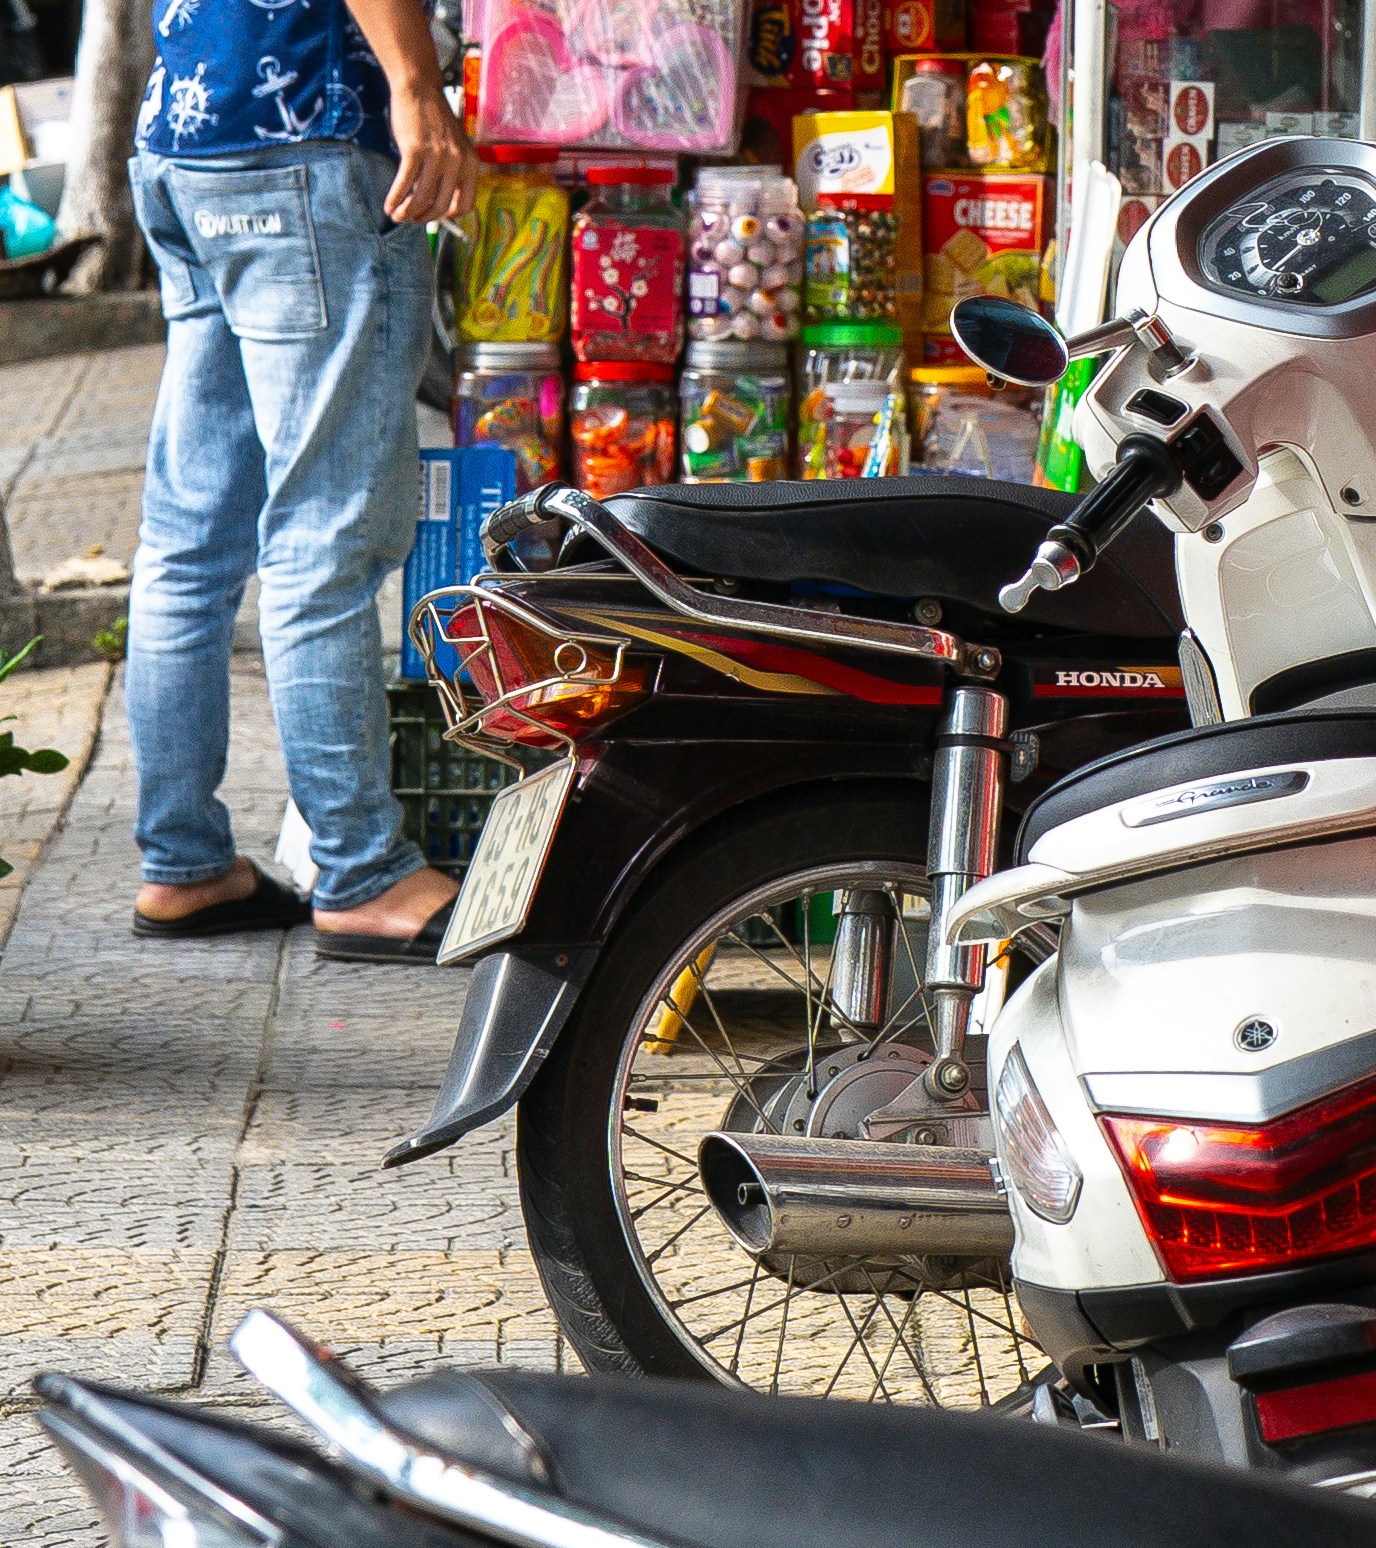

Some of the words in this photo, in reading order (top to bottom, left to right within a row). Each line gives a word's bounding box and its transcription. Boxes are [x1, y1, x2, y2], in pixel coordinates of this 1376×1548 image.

[1298, 189, 1317, 204] 100
[1334, 191, 1353, 207] 120
[954, 197, 1034, 231] CHEESE
[1228, 270, 1242, 282] 20
[1054, 669, 1166, 689] HONDA
